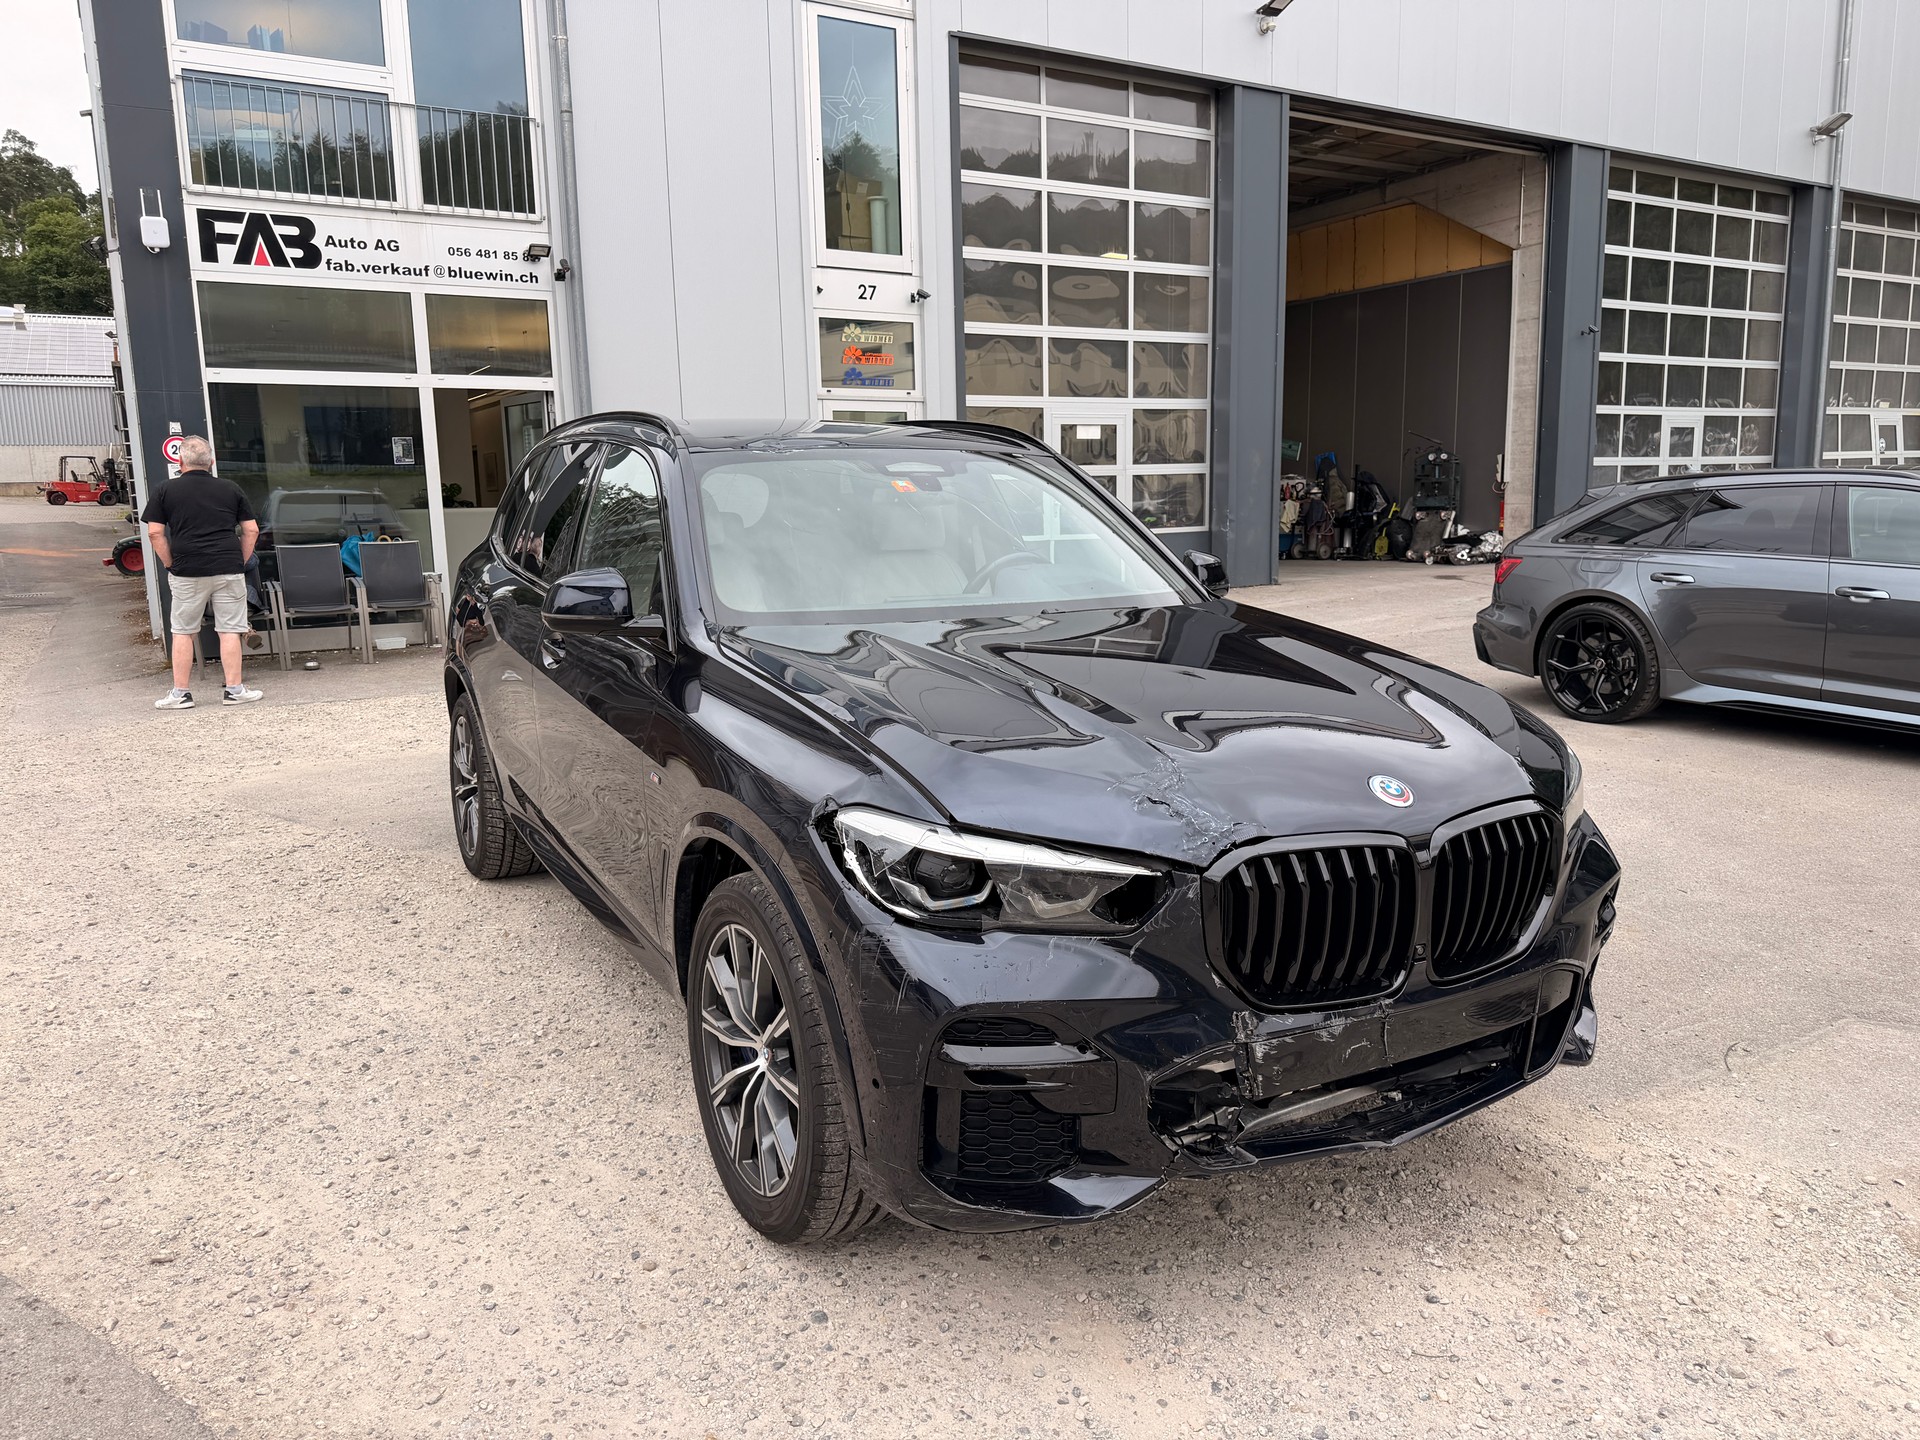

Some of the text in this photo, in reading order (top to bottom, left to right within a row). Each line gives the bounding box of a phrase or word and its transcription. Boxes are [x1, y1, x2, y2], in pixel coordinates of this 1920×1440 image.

[196, 208, 322, 270] FAB
[324, 234, 400, 252] Auto AG
[448, 246, 471, 258] 056
[475, 248, 498, 260] 481
[503, 250, 518, 261] 85
[857, 284, 877, 300] 27
[171, 444, 181, 455] 2
